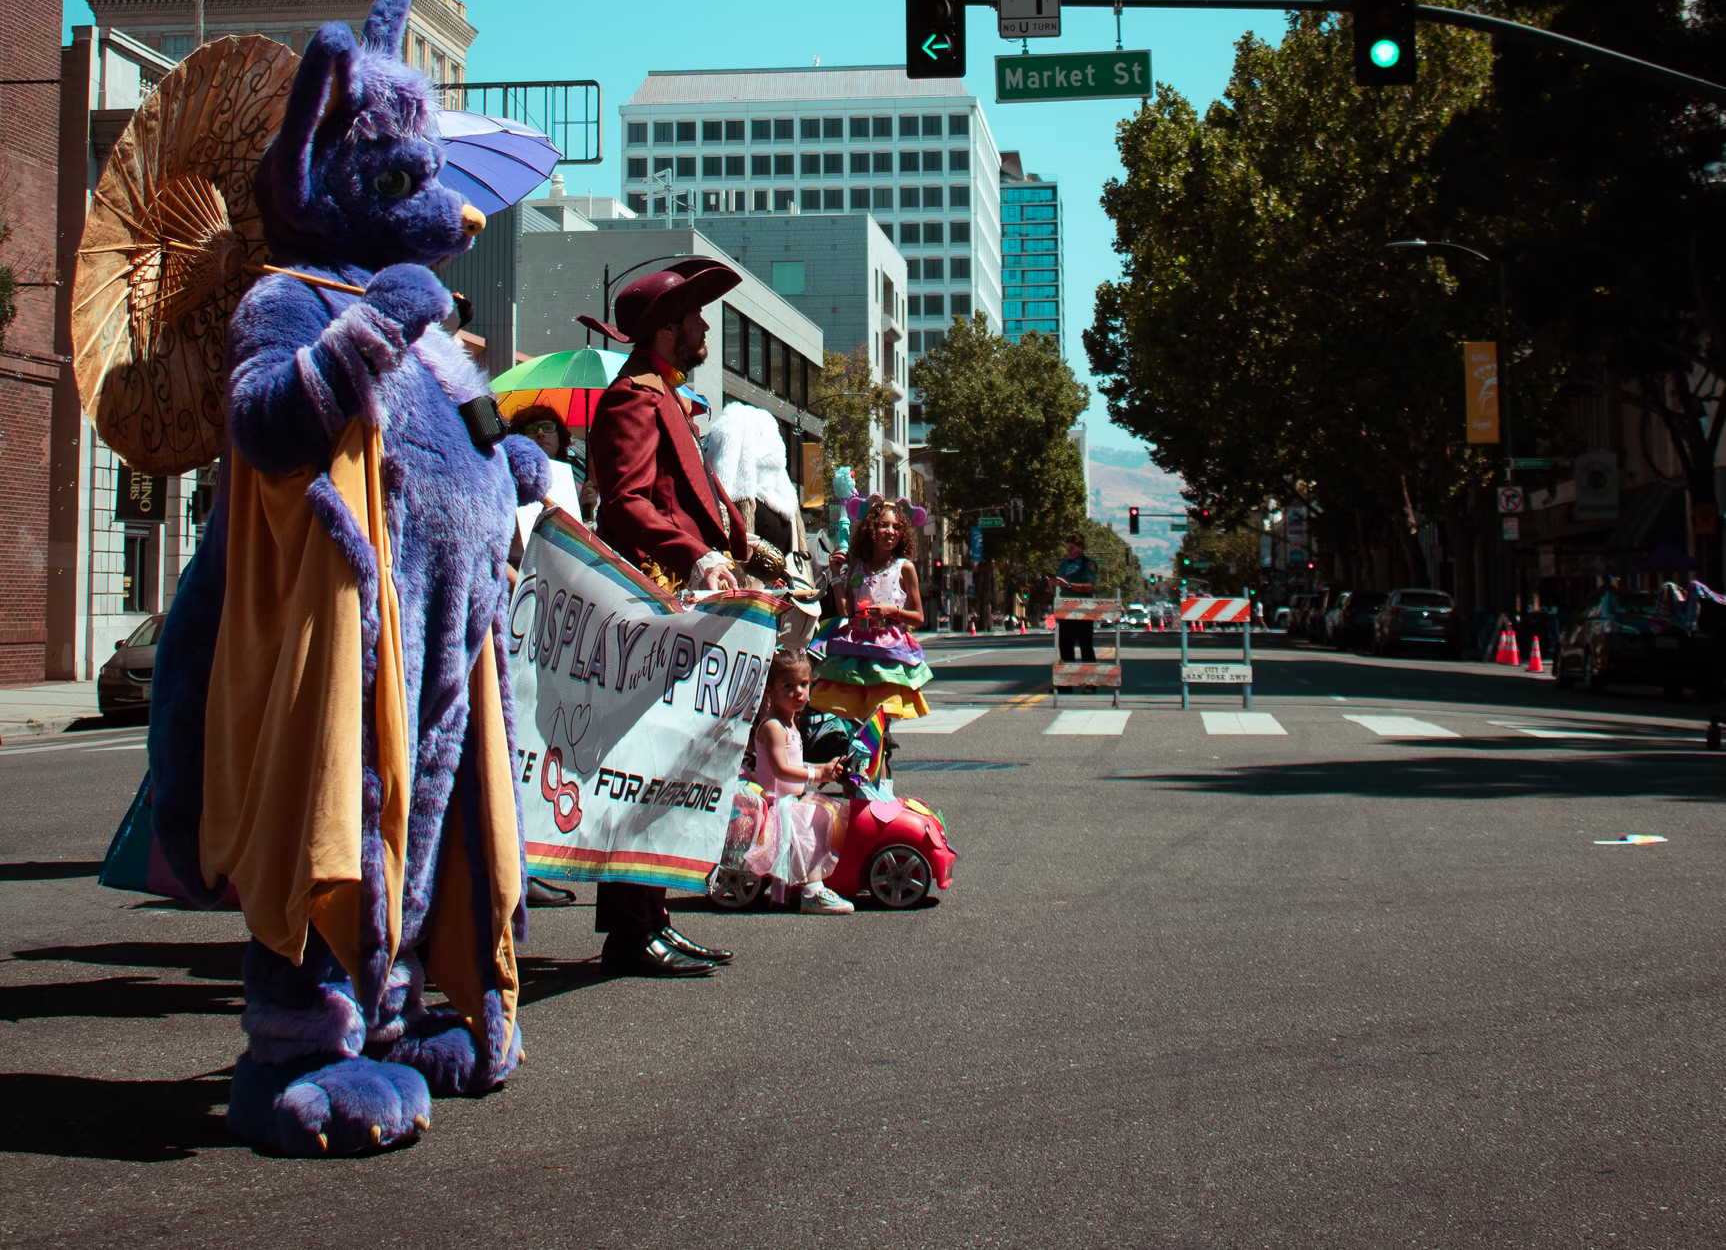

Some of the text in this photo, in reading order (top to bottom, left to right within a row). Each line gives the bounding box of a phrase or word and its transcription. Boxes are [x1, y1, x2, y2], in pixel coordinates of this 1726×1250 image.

[1003, 22, 1057, 33] NO U TURN
[1005, 62, 1142, 89] Market St
[130, 468, 141, 500] LUBS
[140, 472, 153, 512] HINO
[509, 573, 650, 691] COSPLAY
[628, 625, 671, 690] with
[594, 767, 644, 803] FOR
